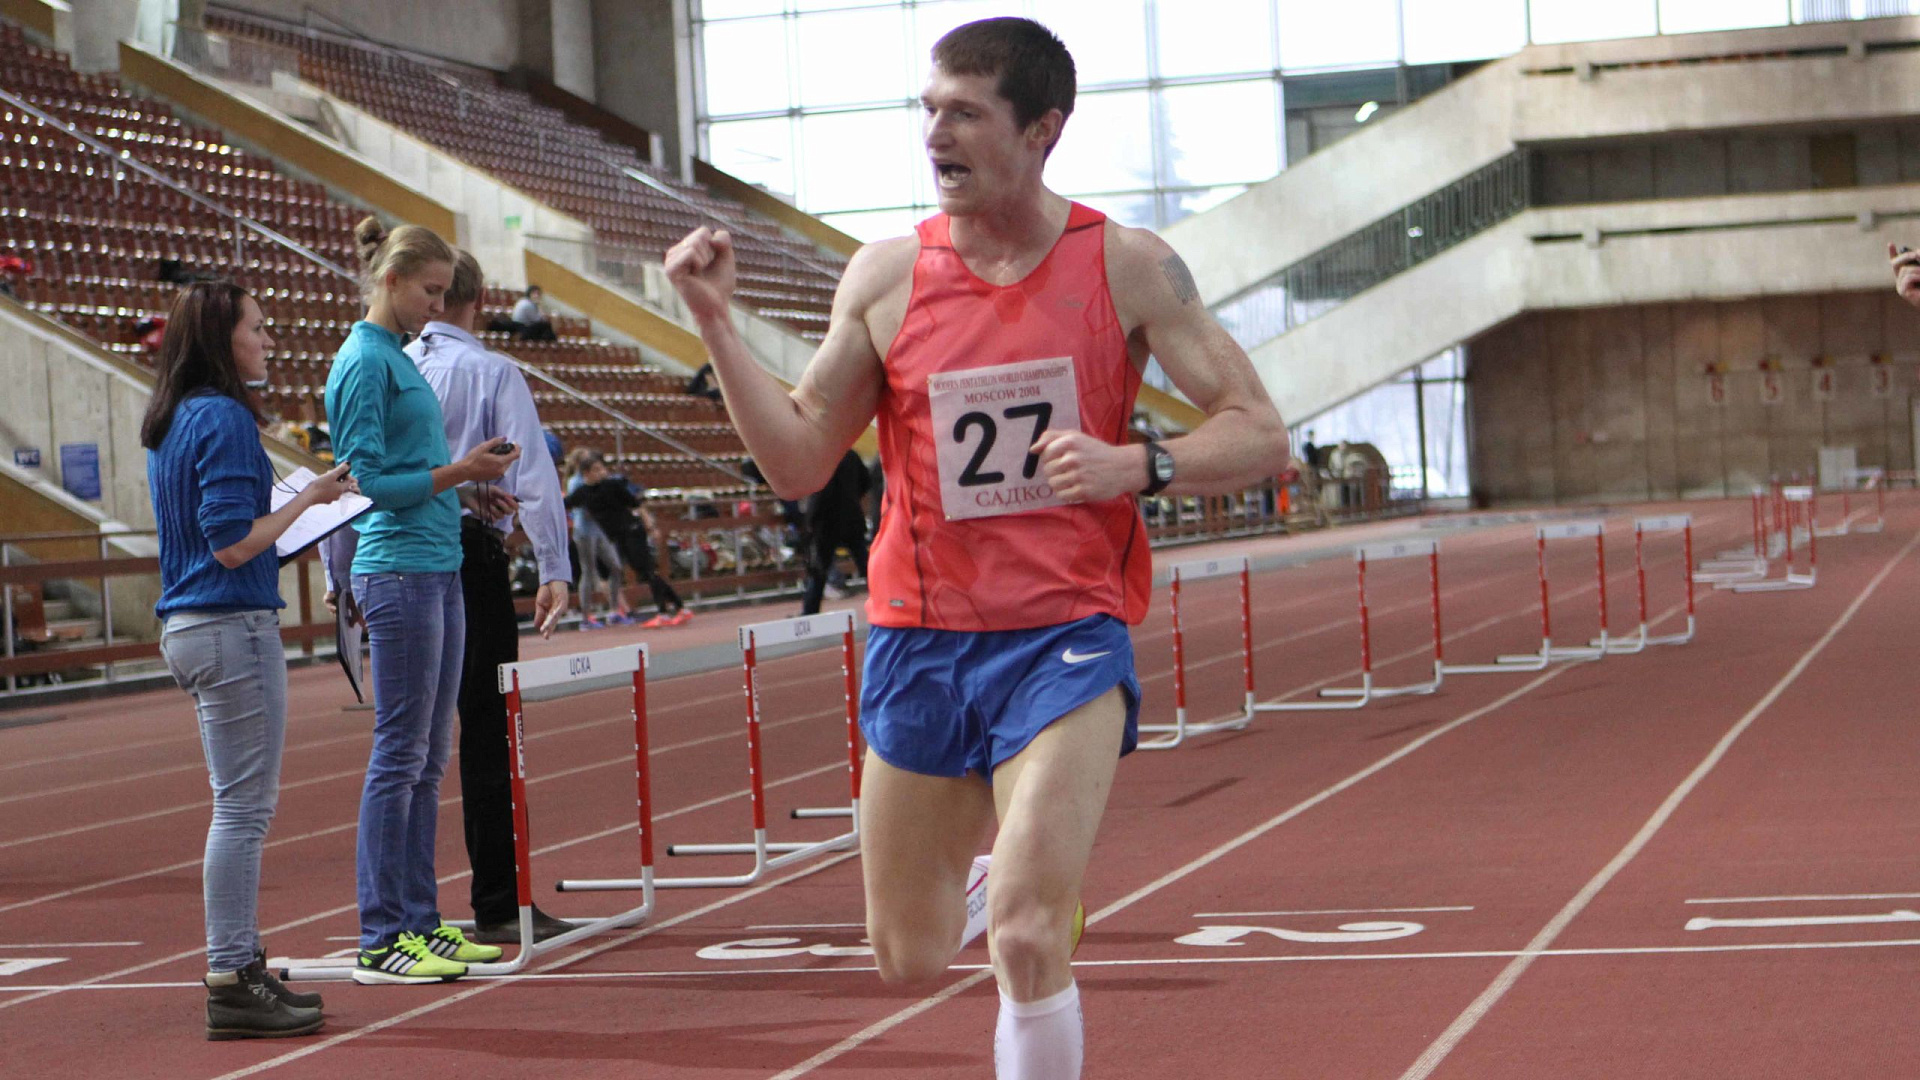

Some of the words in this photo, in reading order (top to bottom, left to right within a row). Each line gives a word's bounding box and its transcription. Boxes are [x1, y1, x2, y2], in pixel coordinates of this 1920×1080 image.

[998, 371, 1020, 384] WORLD
[1020, 366, 1069, 381] CHAMPIONSHIPS
[964, 388, 1016, 405] MOSCOW
[1018, 385, 1041, 399] 2004
[953, 402, 1053, 487] 27
[974, 484, 1054, 507] САДКО
[570, 656, 592, 678] ЦСКА
